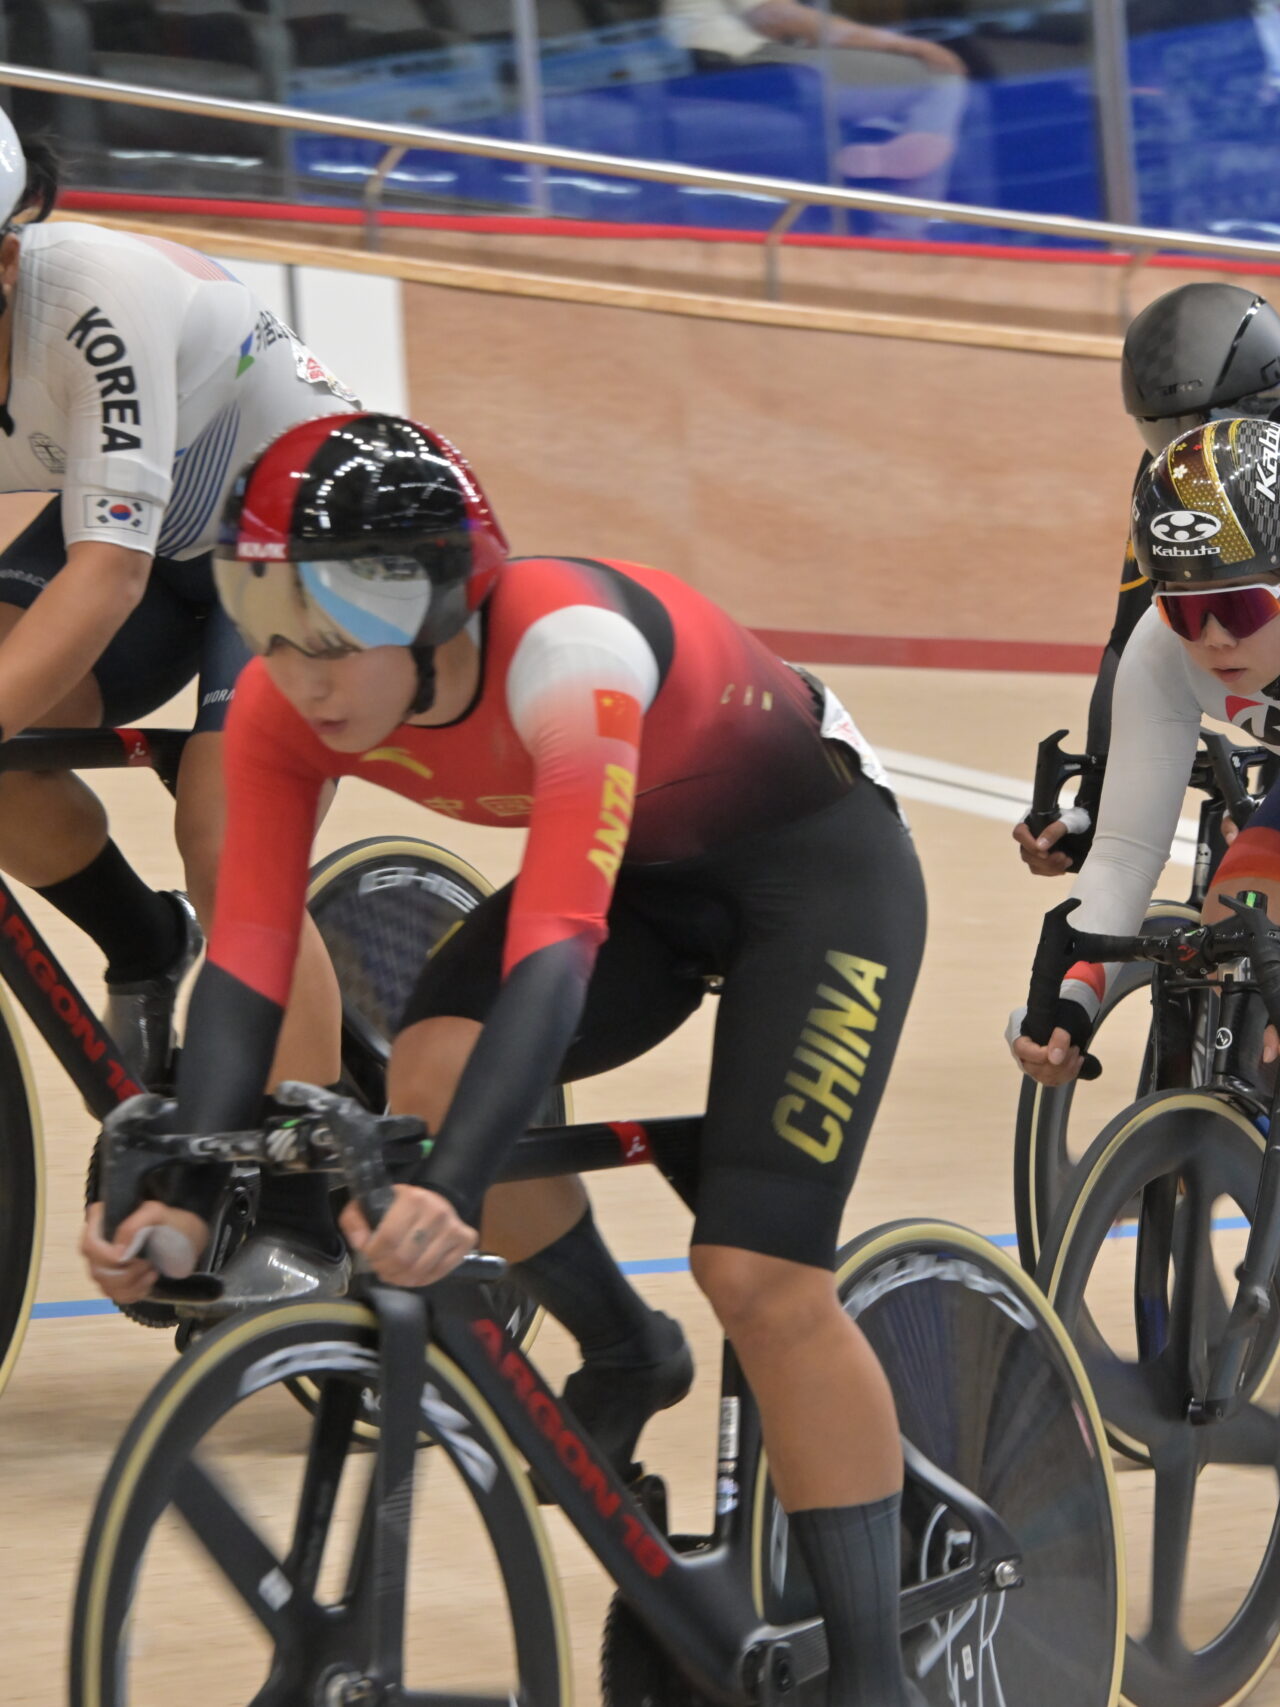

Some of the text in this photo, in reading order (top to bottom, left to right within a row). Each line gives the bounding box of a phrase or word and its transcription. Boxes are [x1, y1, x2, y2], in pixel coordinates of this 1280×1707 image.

[66, 306, 142, 453] KOREA
[1152, 545, 1221, 556] Kabuto
[587, 763, 635, 889] ANTA
[772, 949, 888, 1164] CHINA
[470, 1318, 621, 1519] ARGON
